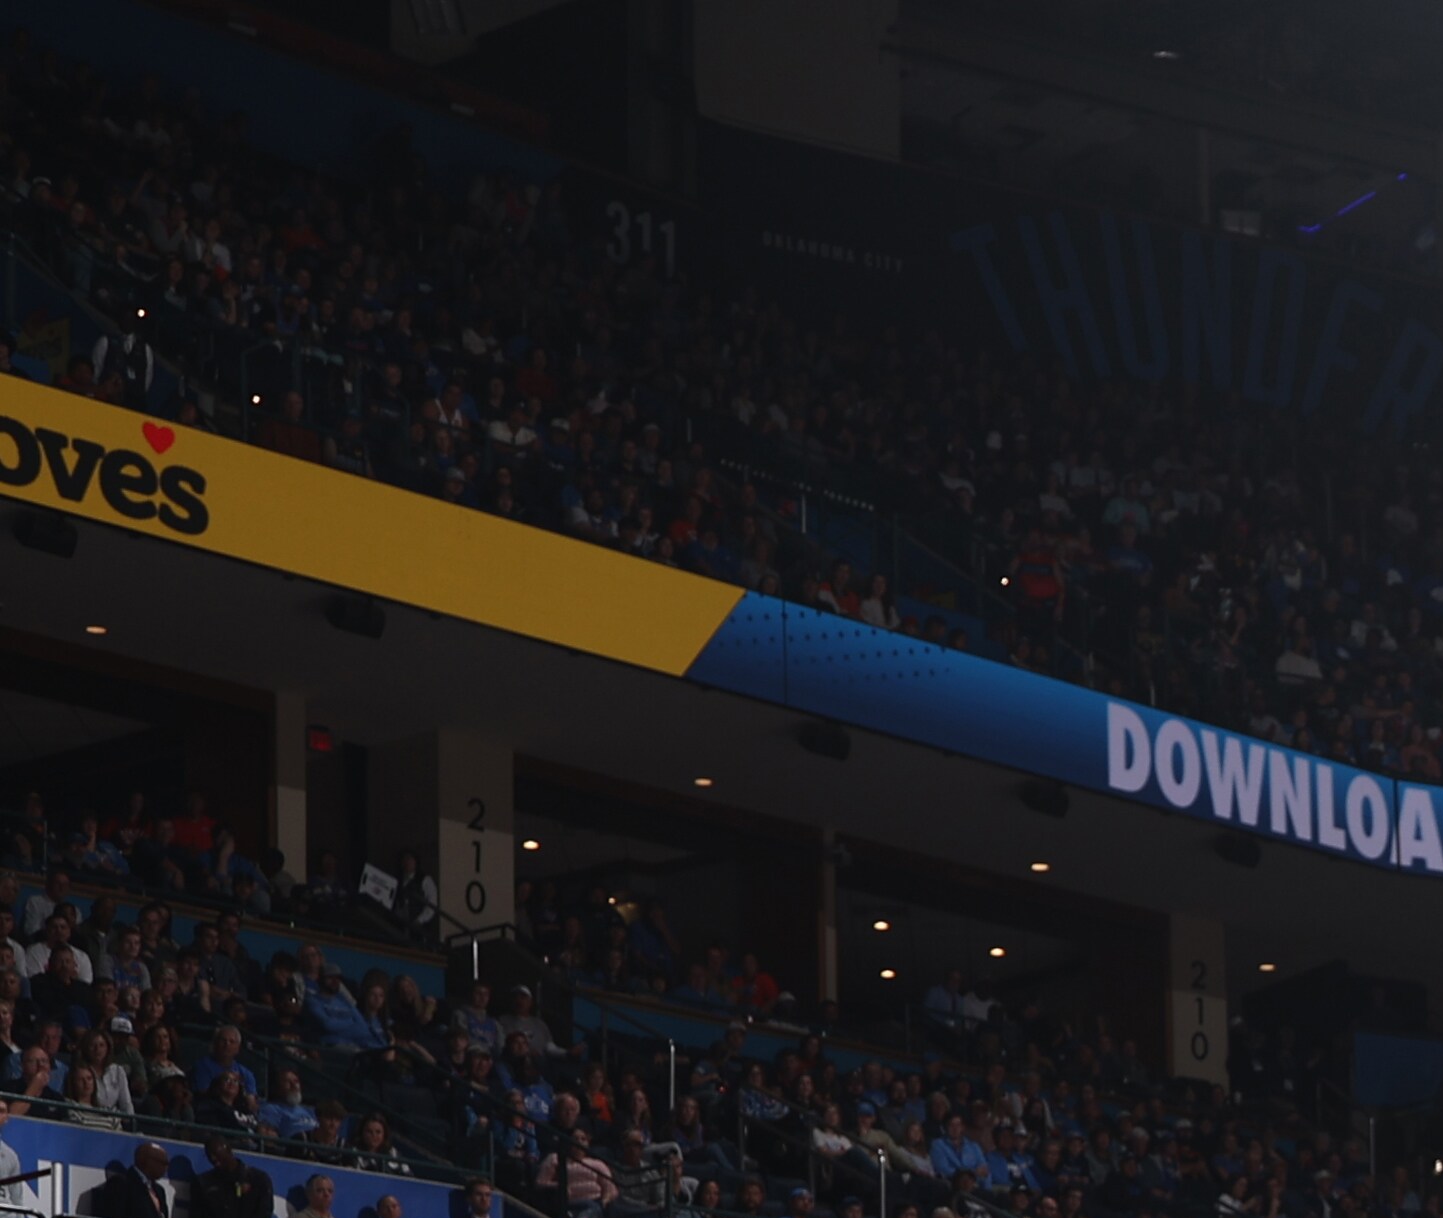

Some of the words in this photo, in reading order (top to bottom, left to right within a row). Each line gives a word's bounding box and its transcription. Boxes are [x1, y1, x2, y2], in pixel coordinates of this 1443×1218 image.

[606, 201, 676, 279] 311
[762, 230, 856, 263] OKLAHOMA
[864, 251, 903, 273] CITY
